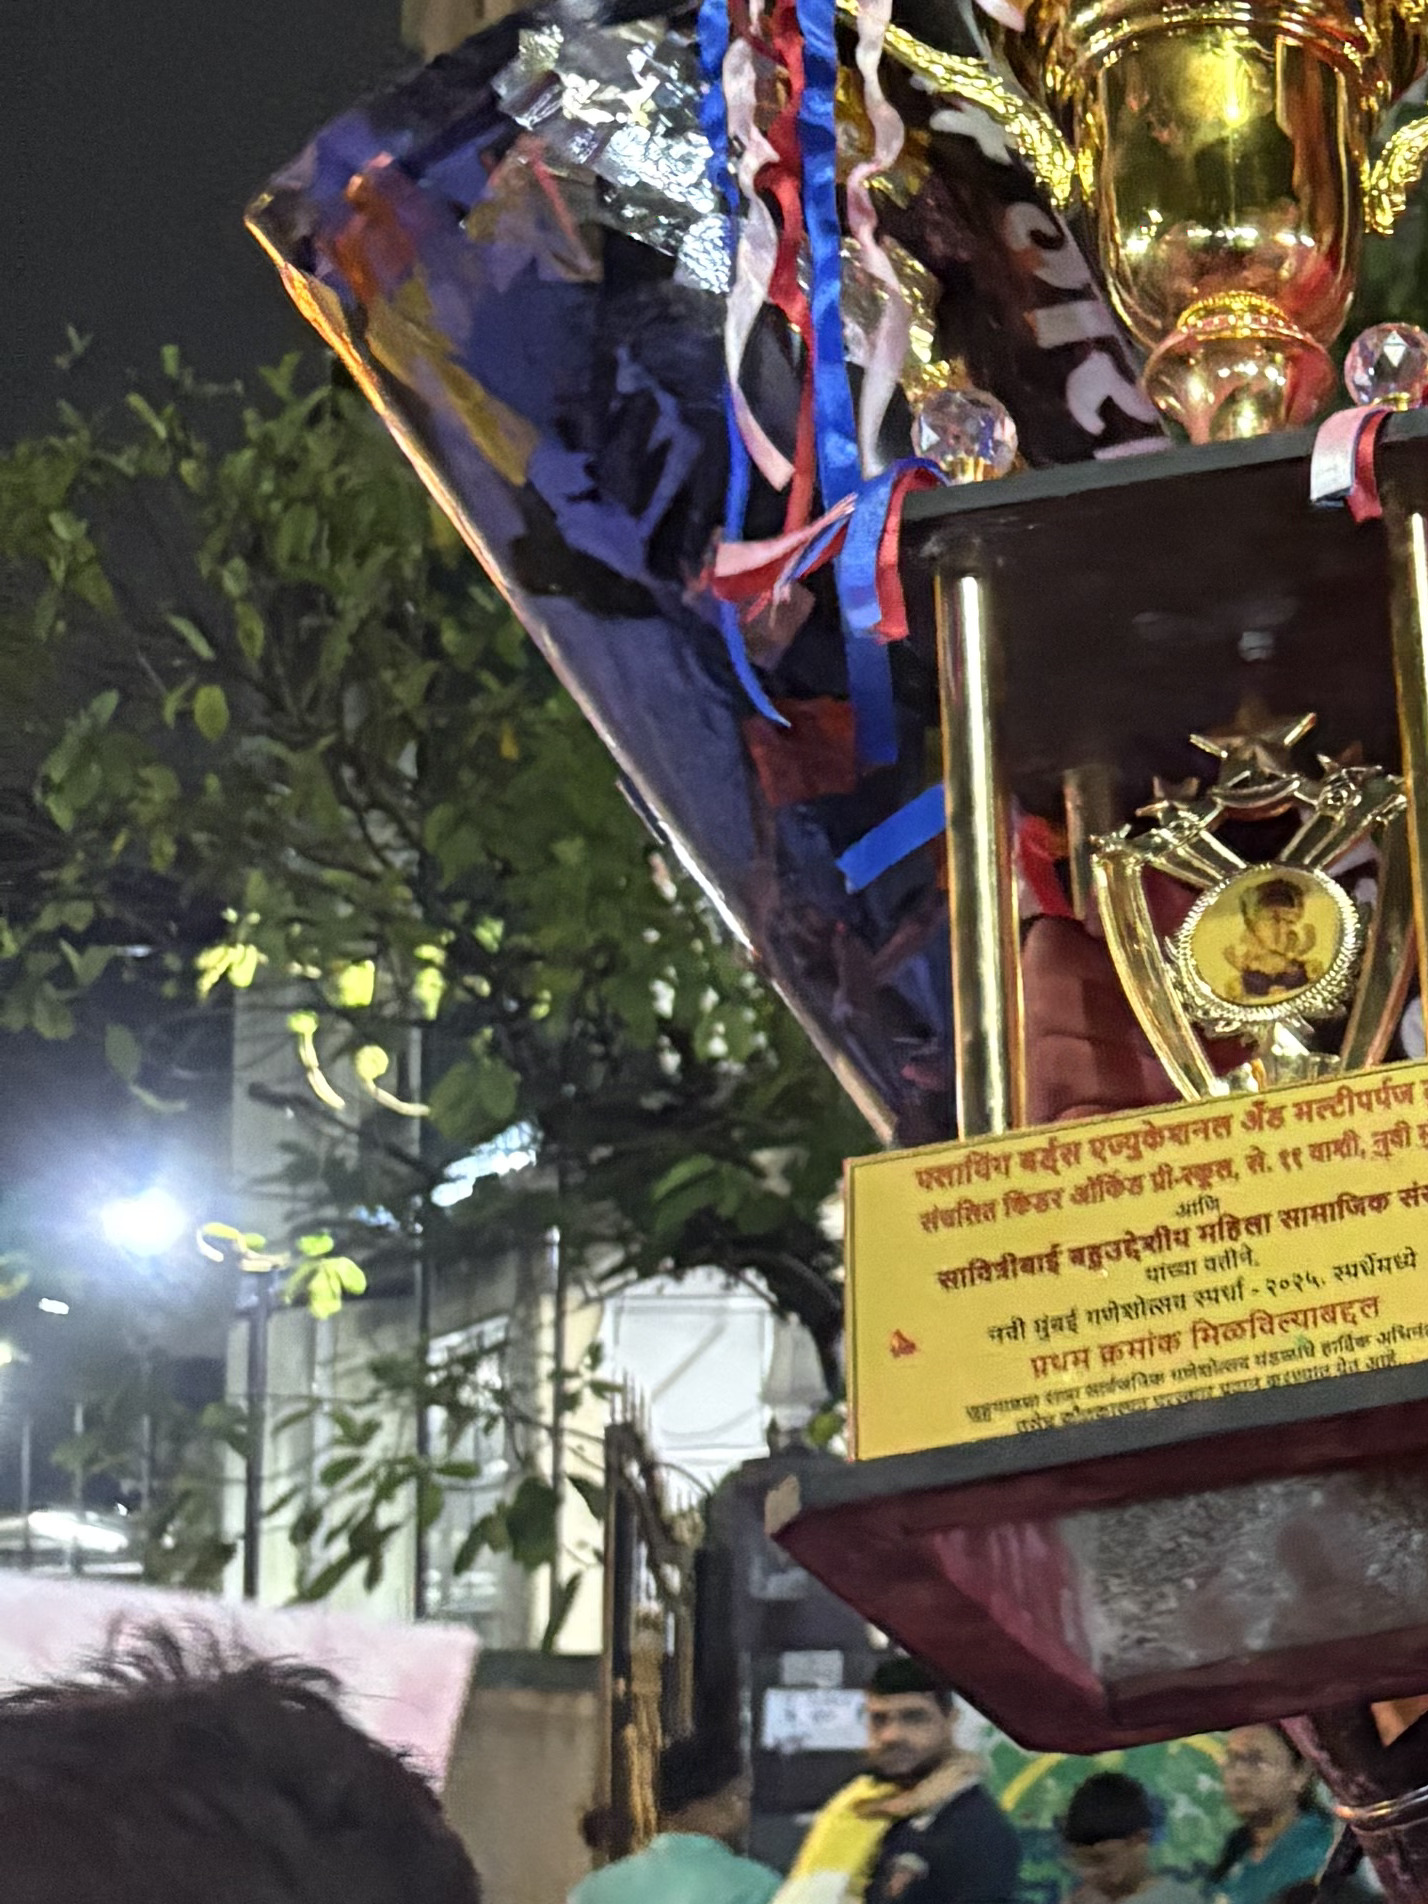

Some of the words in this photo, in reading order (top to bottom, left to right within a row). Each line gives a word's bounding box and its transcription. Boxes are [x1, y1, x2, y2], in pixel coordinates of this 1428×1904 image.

[936, 1243, 1064, 1292] सावित्रीबाई
[1198, 1210, 1272, 1245] महिला
[1277, 1191, 1391, 1231] सामाजिक
[1030, 1346, 1092, 1381] प्रथम
[1098, 1329, 1184, 1367] क्रमांक
[1191, 1294, 1381, 1350] मिळविल्याबद्दल
[1085, 1294, 1188, 1327] गणेशोत्सव
